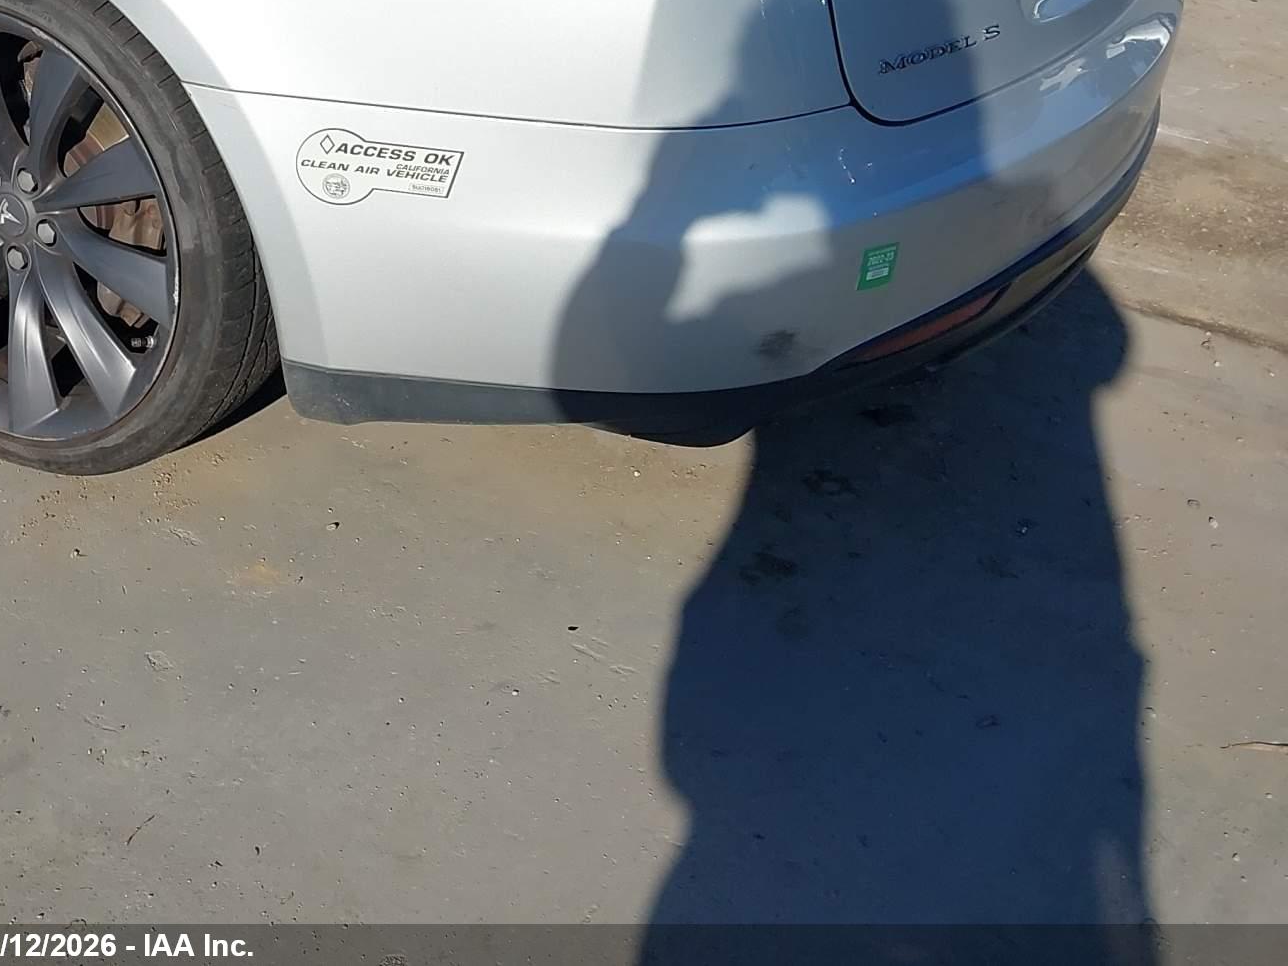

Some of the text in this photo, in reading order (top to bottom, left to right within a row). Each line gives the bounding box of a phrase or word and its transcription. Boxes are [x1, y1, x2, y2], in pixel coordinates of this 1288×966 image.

[878, 24, 1001, 75] MODEL S
[335, 143, 455, 166] ACCESS OK
[301, 159, 449, 184] CLEAN AIR VEHICLE
[396, 163, 450, 176] CALIFORNIA
